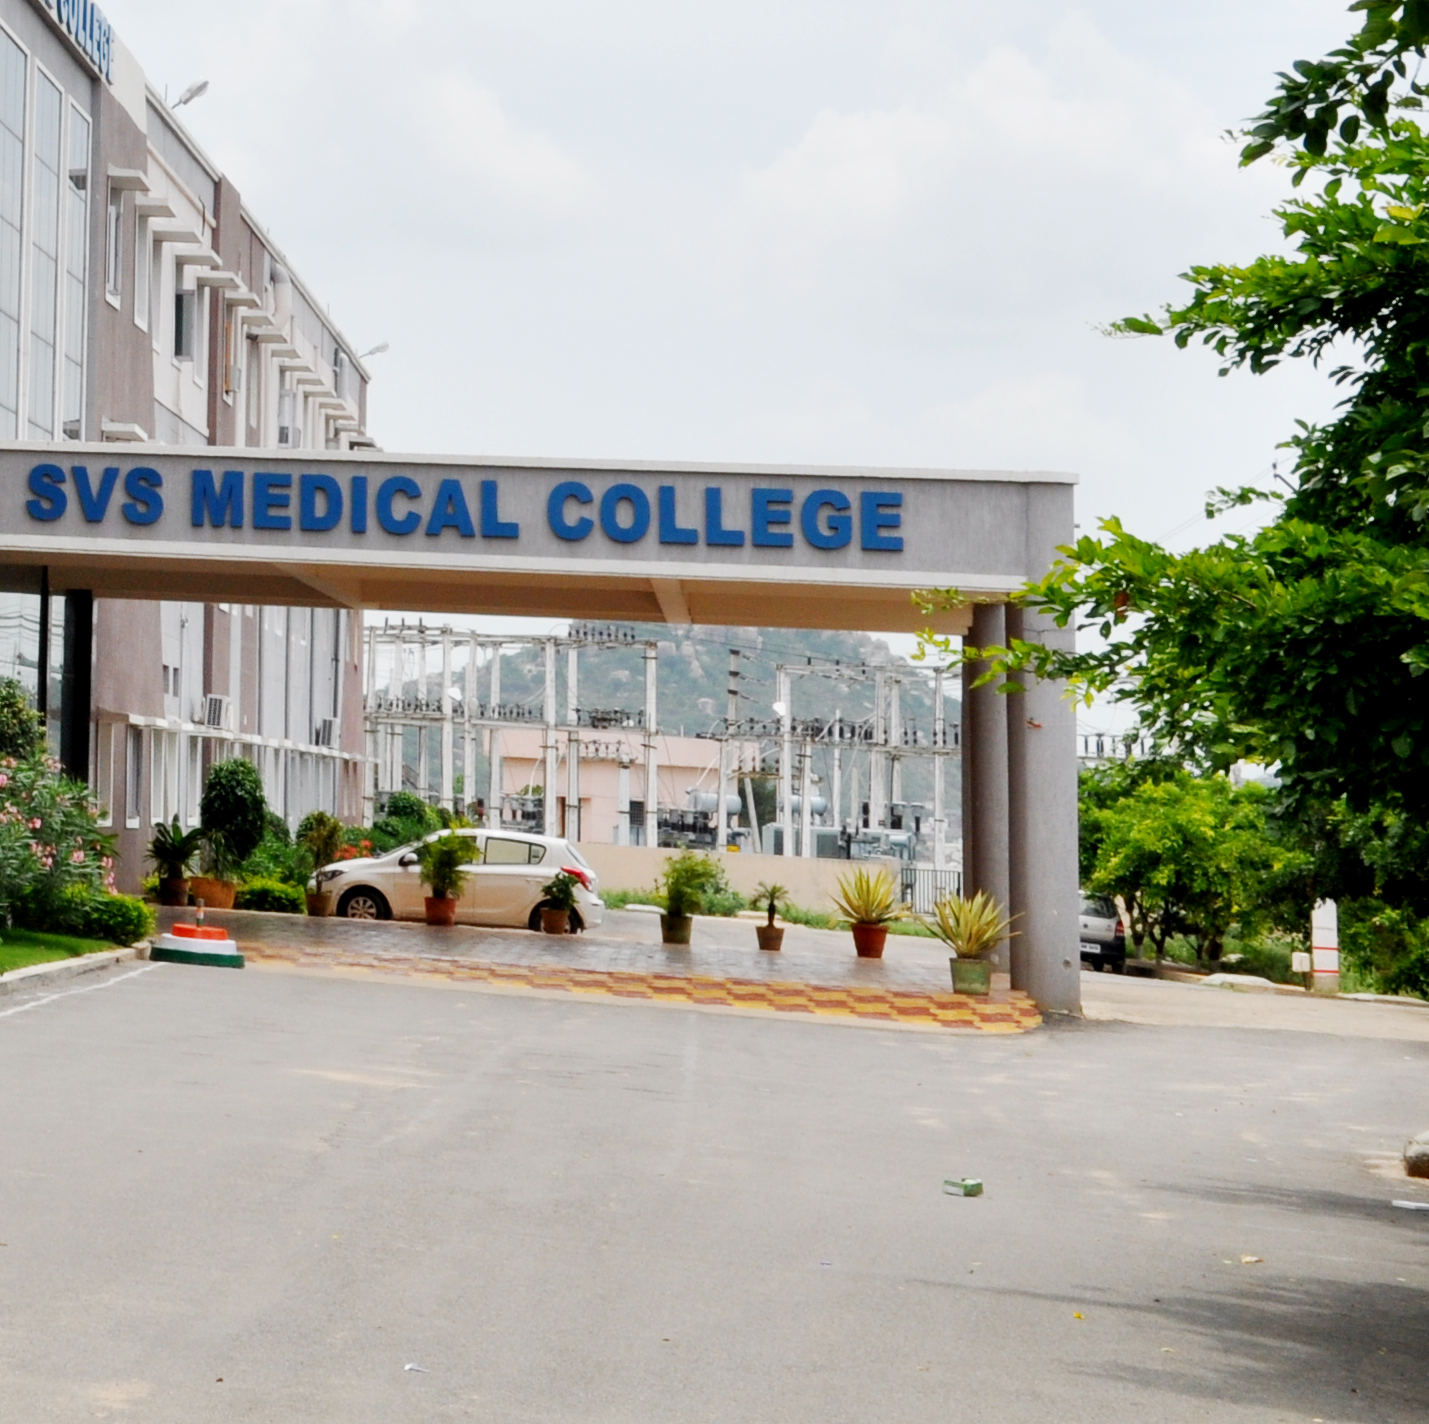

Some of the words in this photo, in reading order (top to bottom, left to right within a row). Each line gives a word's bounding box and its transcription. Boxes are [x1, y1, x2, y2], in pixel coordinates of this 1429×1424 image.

[25, 463, 164, 526] SVS
[191, 469, 519, 539] MEDICAL
[546, 480, 904, 551] COLLEGE
